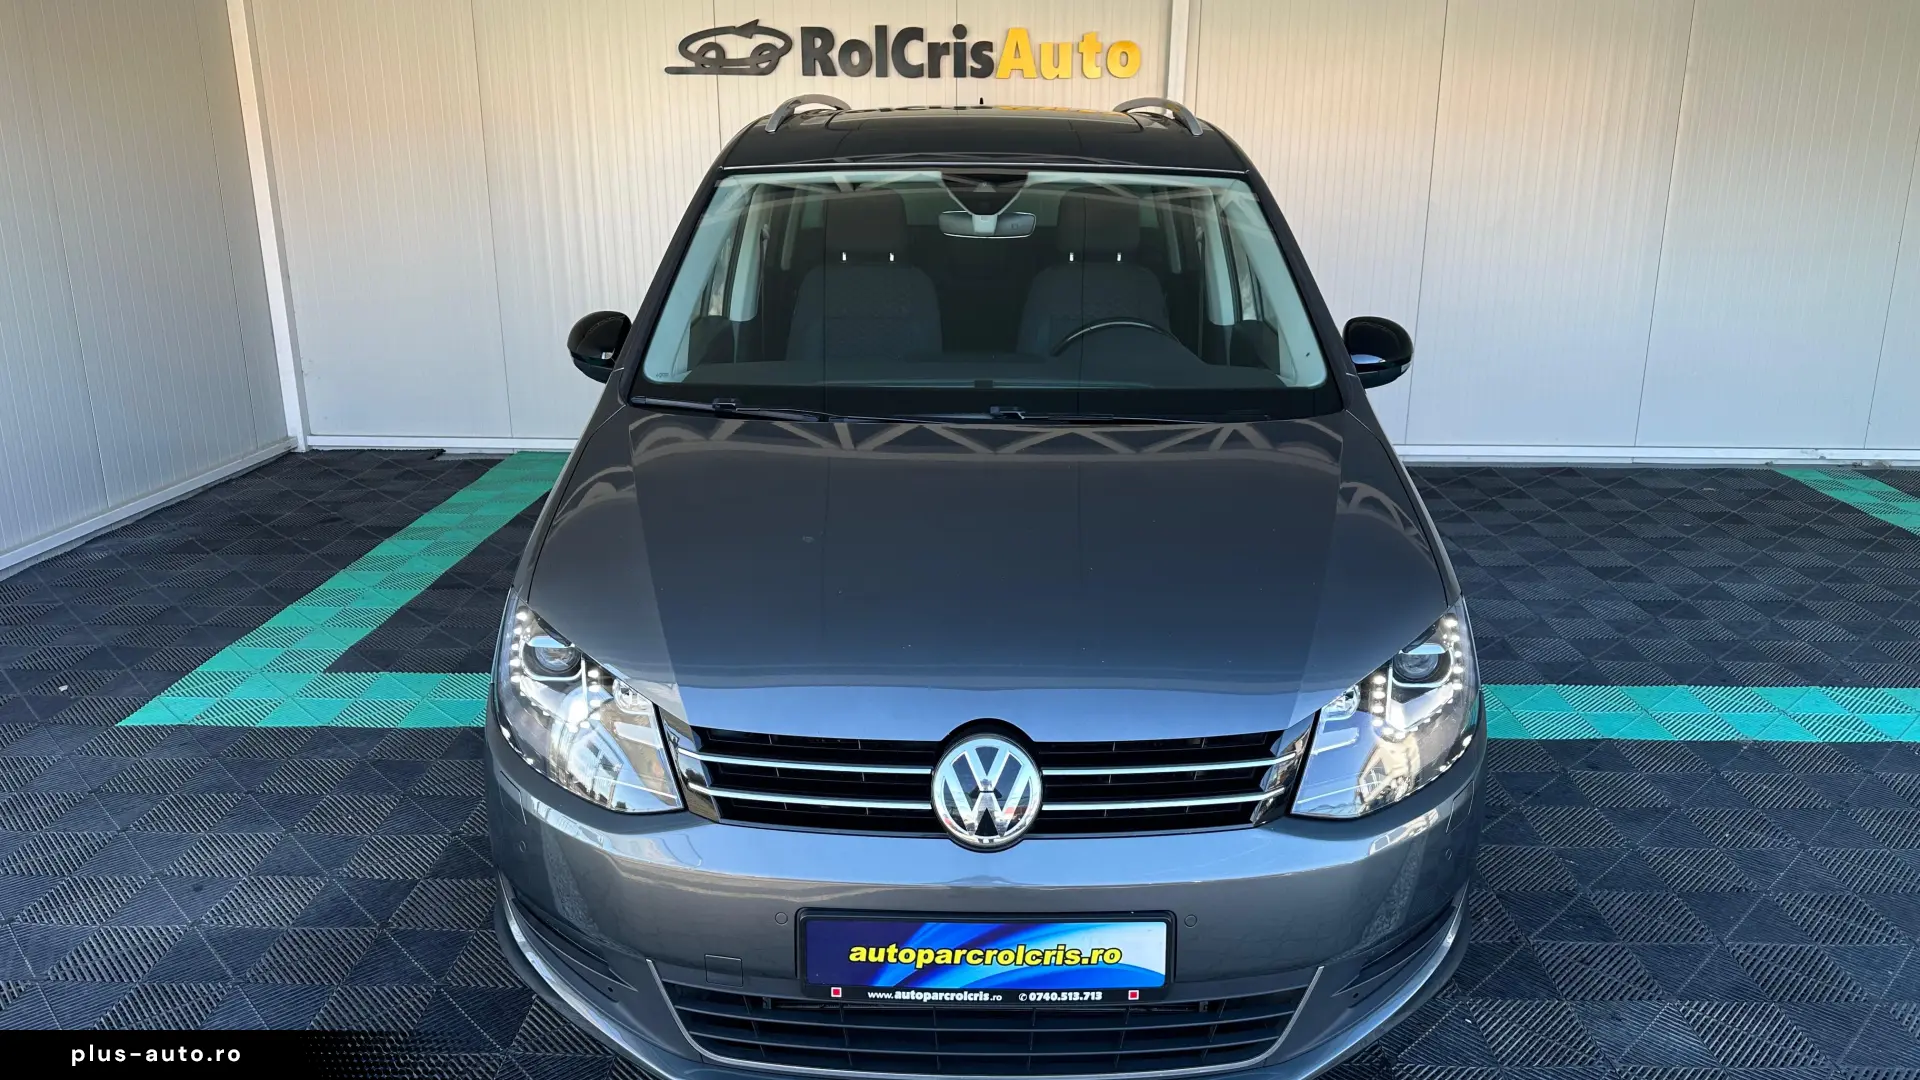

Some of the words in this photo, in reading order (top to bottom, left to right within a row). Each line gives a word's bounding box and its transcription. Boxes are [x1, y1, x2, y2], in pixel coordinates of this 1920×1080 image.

[800, 24, 1142, 79] RolCrisAuto
[938, 738, 1037, 840] VW
[848, 942, 1123, 969] autoparcrolcris.ro
[867, 989, 1003, 1003] www.autoparcrolcris.ro
[1028, 991, 1103, 1002] 0740.513.713
